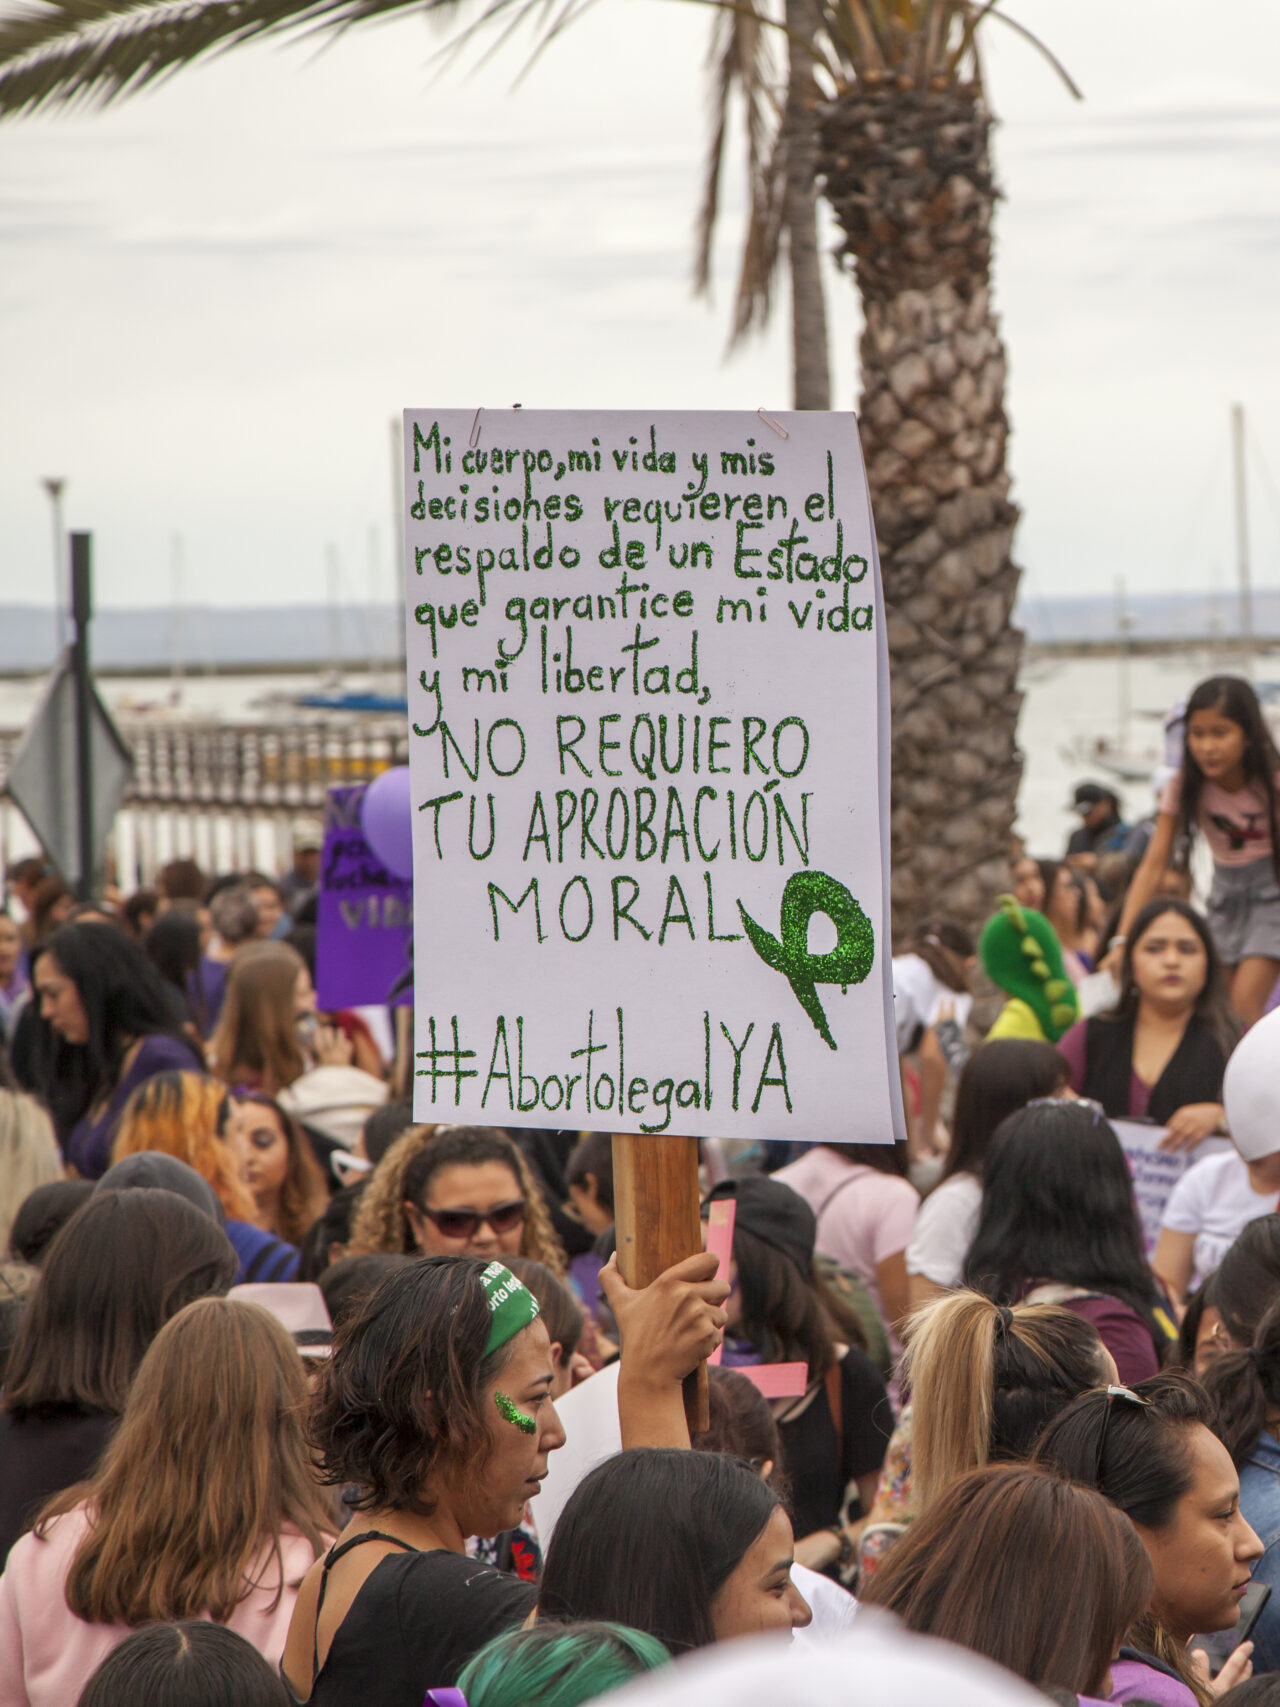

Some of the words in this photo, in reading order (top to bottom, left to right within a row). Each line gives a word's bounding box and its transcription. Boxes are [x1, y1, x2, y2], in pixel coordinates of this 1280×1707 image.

[410, 480, 583, 523] decisiones
[604, 486, 788, 551] requieren
[804, 449, 836, 522] el
[413, 421, 451, 475] Mi
[612, 425, 676, 474] vida
[682, 451, 708, 501] y
[721, 438, 775, 477] mis
[414, 521, 581, 606] respaldo
[599, 520, 647, 570] de
[668, 539, 714, 569] un
[733, 518, 869, 584] Estado
[414, 599, 479, 658] que
[498, 571, 695, 661] garantice
[716, 585, 768, 623] mi
[788, 581, 874, 632] vida
[412, 669, 443, 737] y
[462, 658, 511, 693] mi
[540, 622, 712, 705] libertad,
[439, 717, 527, 781] NO
[556, 713, 810, 781] REQUIERO
[418, 790, 496, 861] TU
[523, 779, 814, 866] APROBACIÓN
[339, 894, 412, 933] VID
[487, 870, 745, 945] MORAL
[489, 1288, 509, 1311] orto
